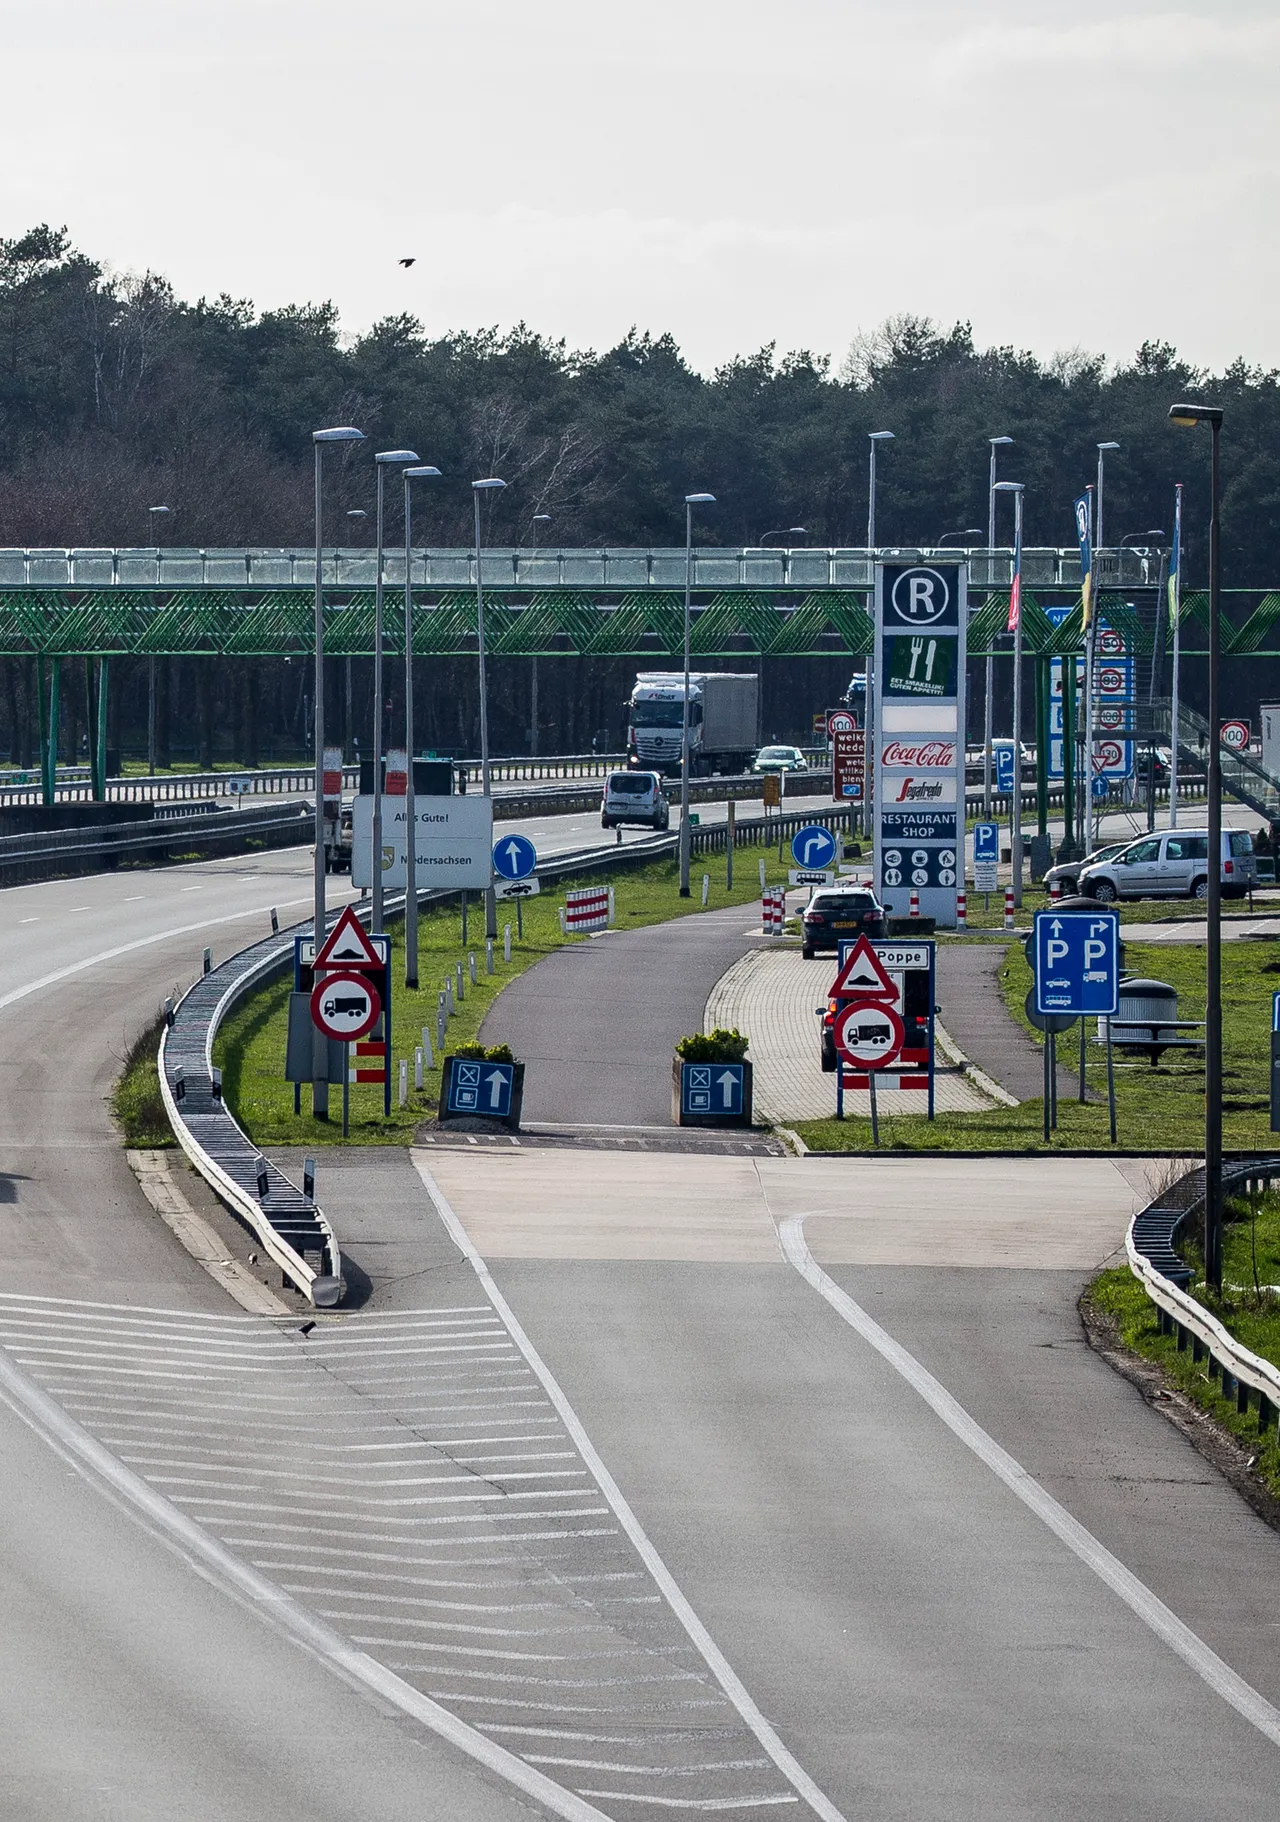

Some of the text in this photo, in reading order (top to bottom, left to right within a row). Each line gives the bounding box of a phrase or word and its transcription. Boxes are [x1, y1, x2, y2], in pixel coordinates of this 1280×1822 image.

[909, 577, 935, 614] R
[833, 720, 851, 731] 100
[838, 733, 865, 742] welko
[1225, 730, 1243, 742] 100
[882, 742, 956, 767] Coca-Cola
[999, 751, 1012, 768] P
[896, 778, 943, 803] Segafredo
[394, 813, 449, 823] Als Gute!
[882, 814, 956, 824] RESTAURANT
[902, 827, 935, 837] SHOP
[979, 826, 993, 846] P
[400, 855, 472, 865] Ndersachsen
[877, 951, 921, 963] Poppe
[1047, 939, 1107, 970] P P
